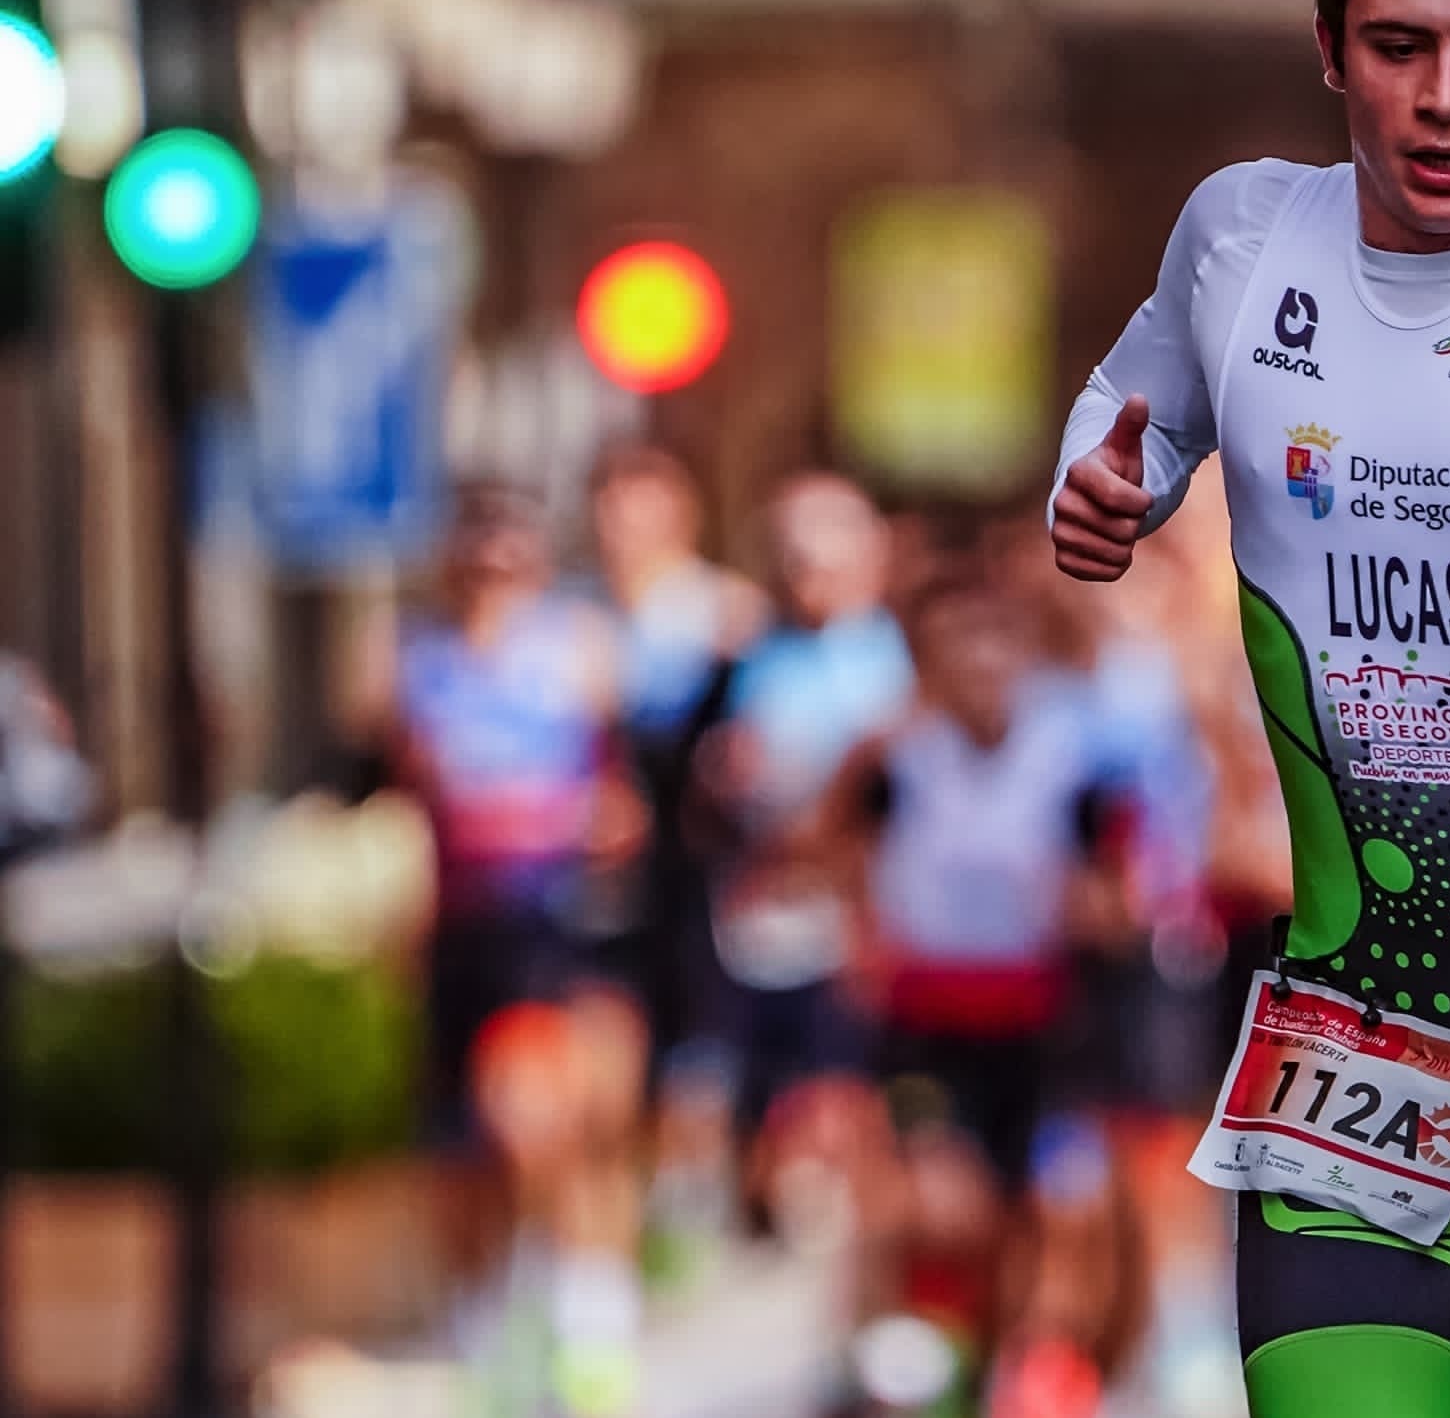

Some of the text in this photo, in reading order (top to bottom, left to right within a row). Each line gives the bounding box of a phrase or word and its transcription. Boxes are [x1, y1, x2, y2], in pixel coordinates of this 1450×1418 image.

[1253, 347, 1325, 381] austral
[1350, 492, 1385, 519] de
[1342, 721, 1371, 736] DE
[1353, 763, 1398, 780] Pueblos
[1402, 769, 1419, 780] en
[1263, 1013, 1278, 1026] de
[1323, 1026, 1361, 1051] Clubes
[1327, 1018, 1344, 1032] de
[1303, 1039, 1349, 1063] LACERTA
[1268, 1061, 1421, 1162] 112A
